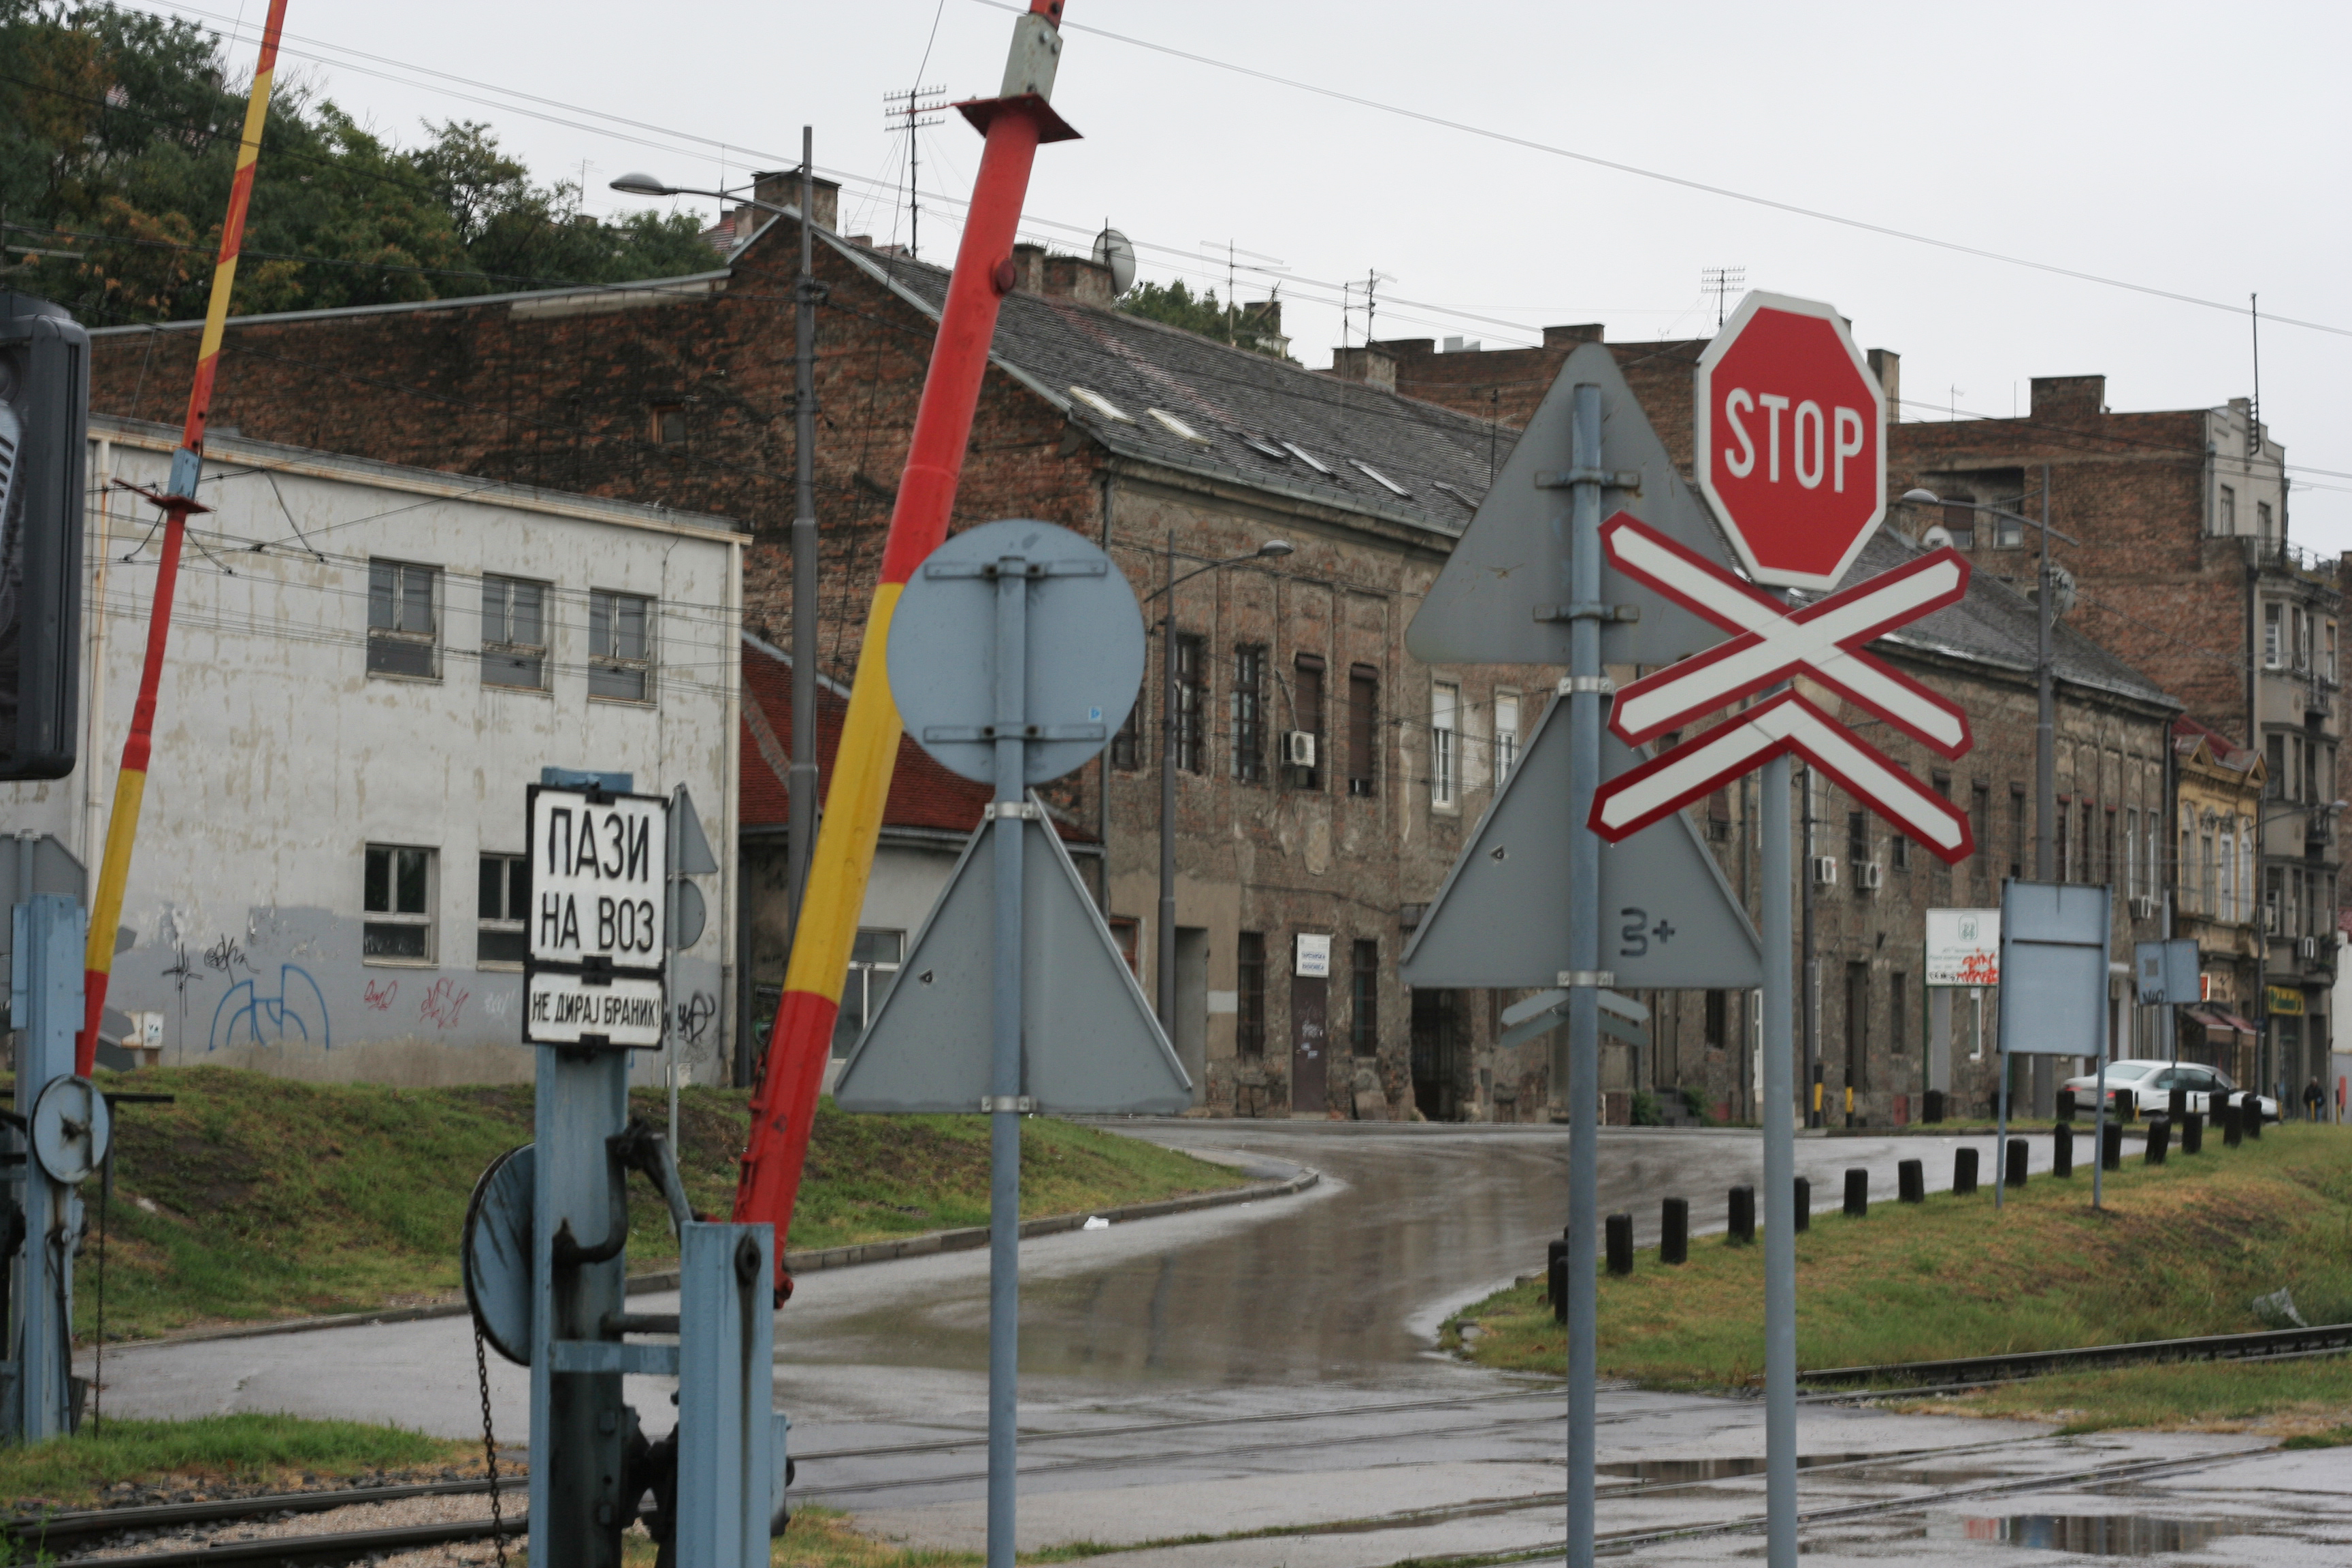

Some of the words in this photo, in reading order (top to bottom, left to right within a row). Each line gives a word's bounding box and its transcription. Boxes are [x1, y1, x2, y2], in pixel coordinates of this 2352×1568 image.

[1725, 387, 1864, 493] STOP
[549, 807, 649, 882] ПАЗИ
[541, 891, 580, 949] НА
[598, 896, 655, 953] ВОЗ
[531, 991, 551, 1022] НЕ
[555, 994, 600, 1024] ДИРАЈ
[604, 996, 660, 1027] БРАНИК!
